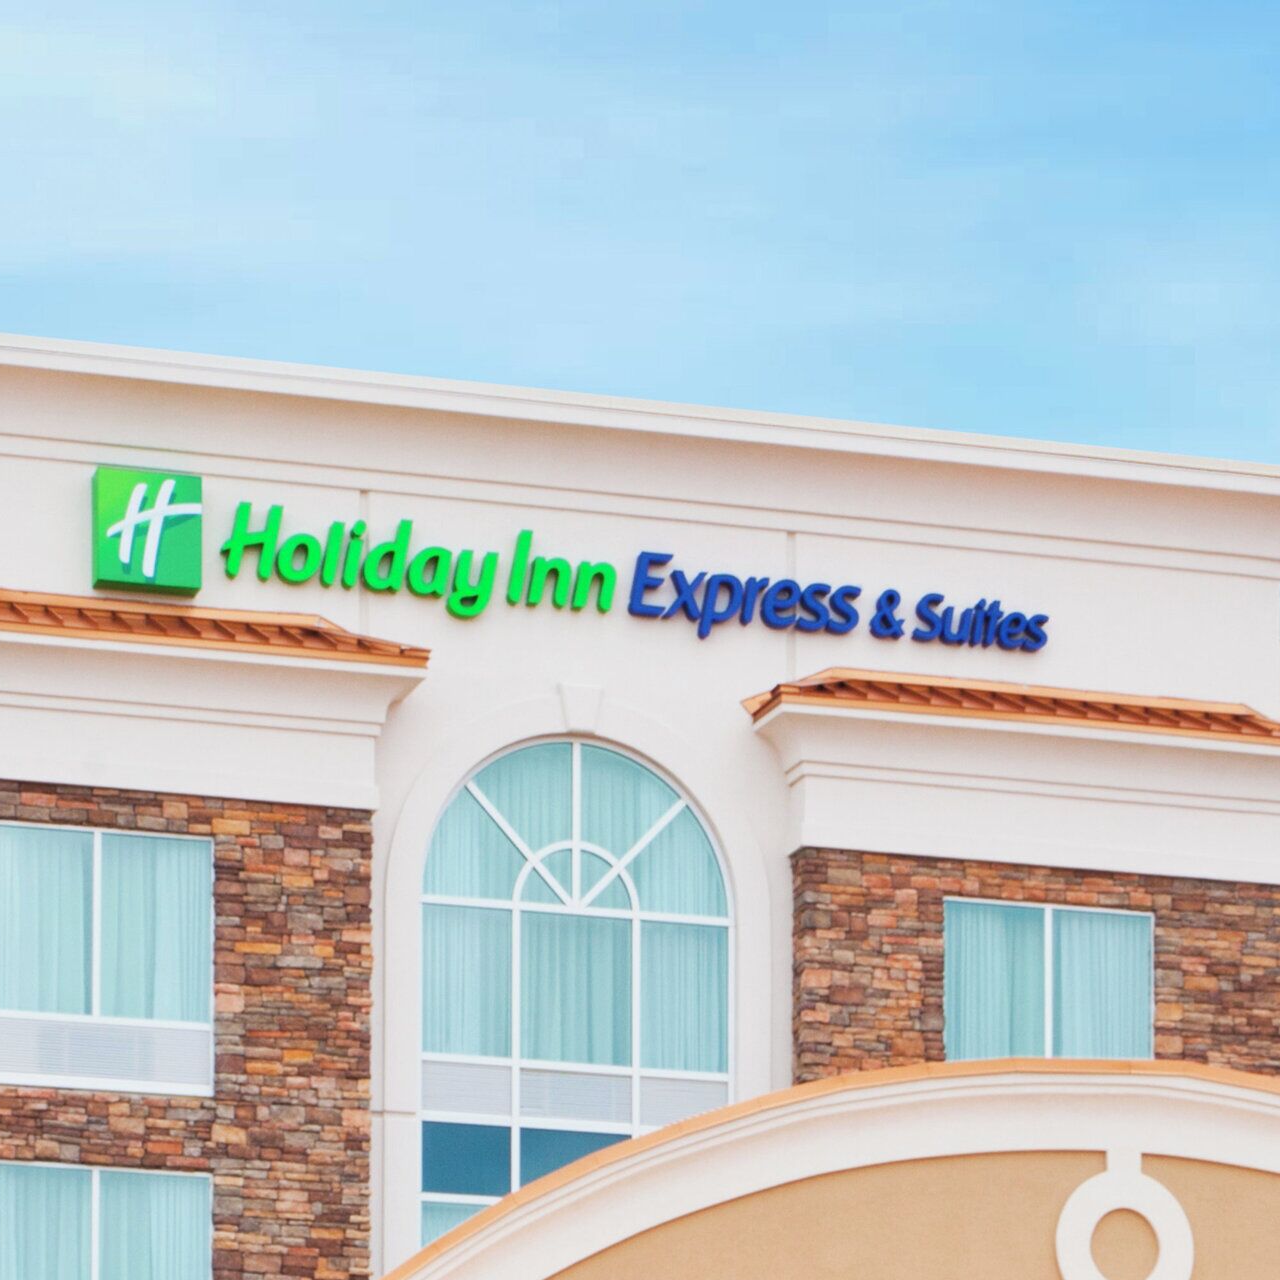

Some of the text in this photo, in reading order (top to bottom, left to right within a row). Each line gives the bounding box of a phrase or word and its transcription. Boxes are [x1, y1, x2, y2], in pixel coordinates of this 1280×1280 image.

[219, 500, 1050, 652] Holiday Inn Express & Suites
